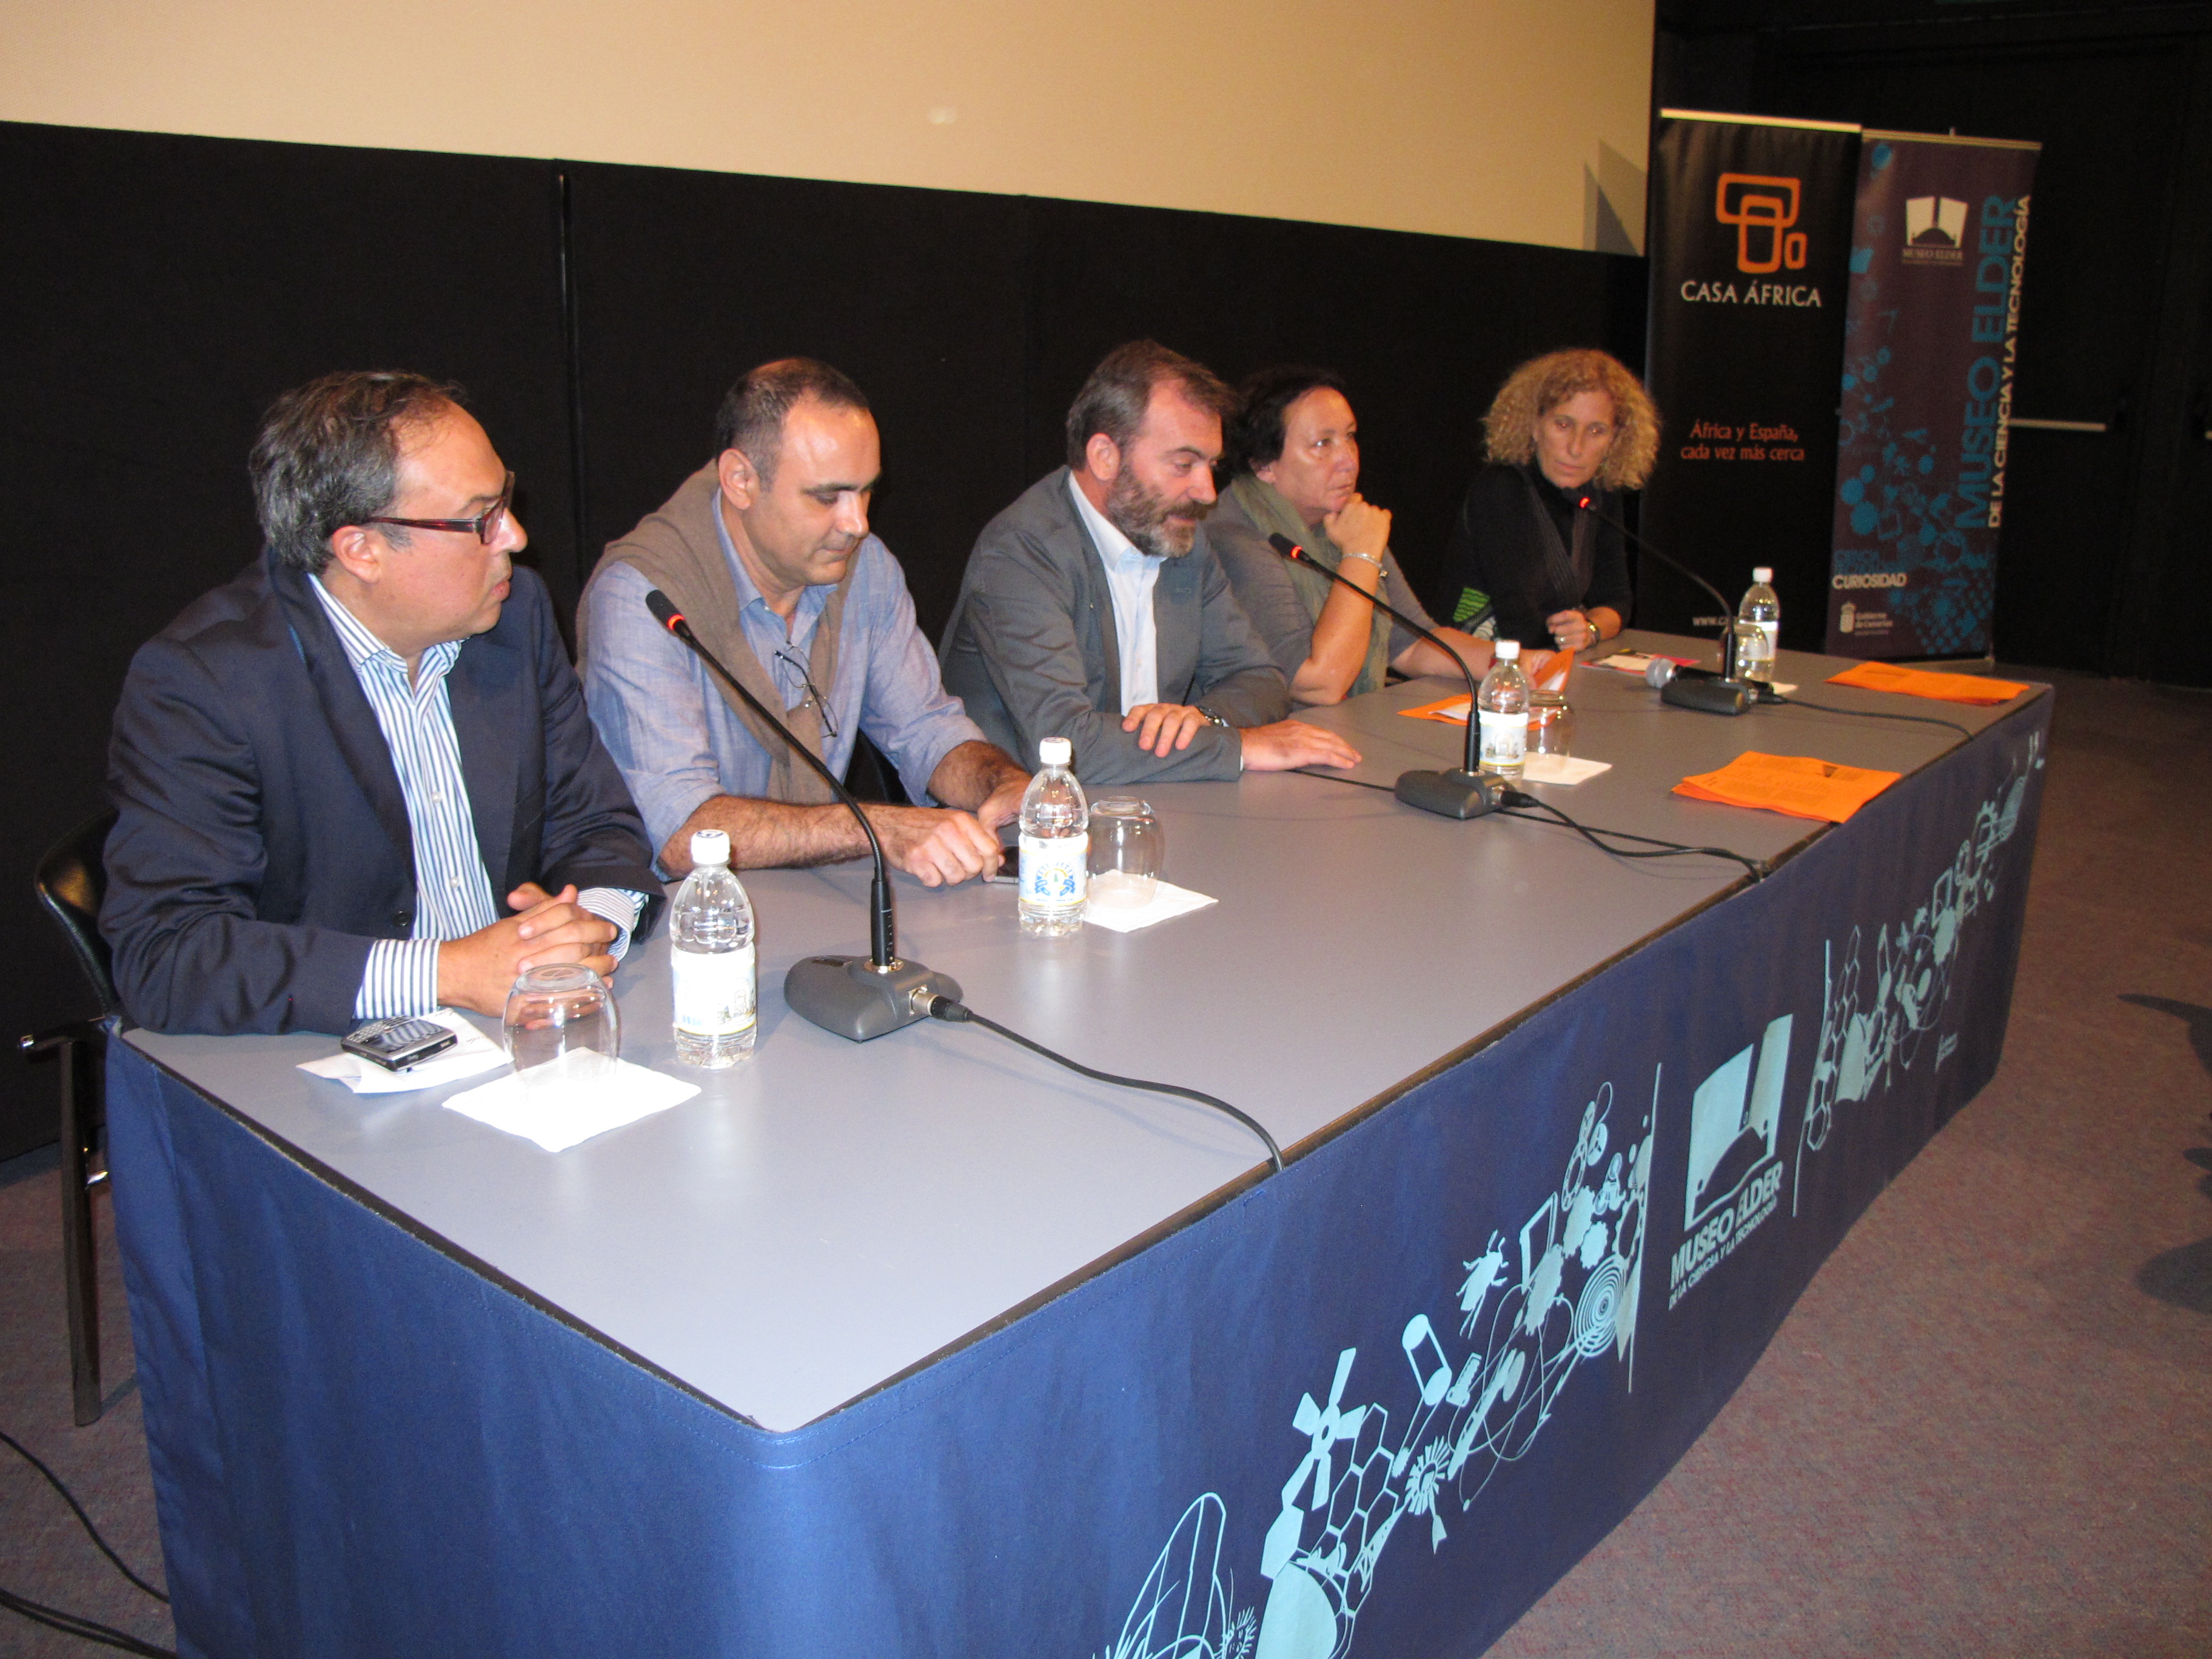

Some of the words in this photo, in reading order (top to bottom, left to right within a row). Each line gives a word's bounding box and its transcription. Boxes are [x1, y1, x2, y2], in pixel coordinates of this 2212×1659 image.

[1971, 195, 2017, 343] ELDER
[2005, 194, 2031, 332] TECNOLOGÍA
[1680, 280, 1739, 303] CASA
[1743, 279, 1823, 307] ÁFRICA
[2002, 336, 2018, 363] LA
[2002, 366, 2015, 380] Y
[1689, 419, 1732, 439] África
[1736, 426, 1746, 442] y
[1994, 381, 2014, 468] CIENCIA
[1681, 443, 1711, 460] cada
[1714, 447, 1737, 460] vez
[1740, 444, 1766, 460] más
[1769, 447, 1806, 461] cerca
[1954, 356, 2002, 528] MUSEO
[1991, 471, 2005, 497] LA
[1988, 500, 2003, 528] DE
[1831, 572, 1909, 591] CURIOSIDAD
[1670, 1207, 1735, 1290] MUSEO
[1735, 1161, 1783, 1229] ELDER
